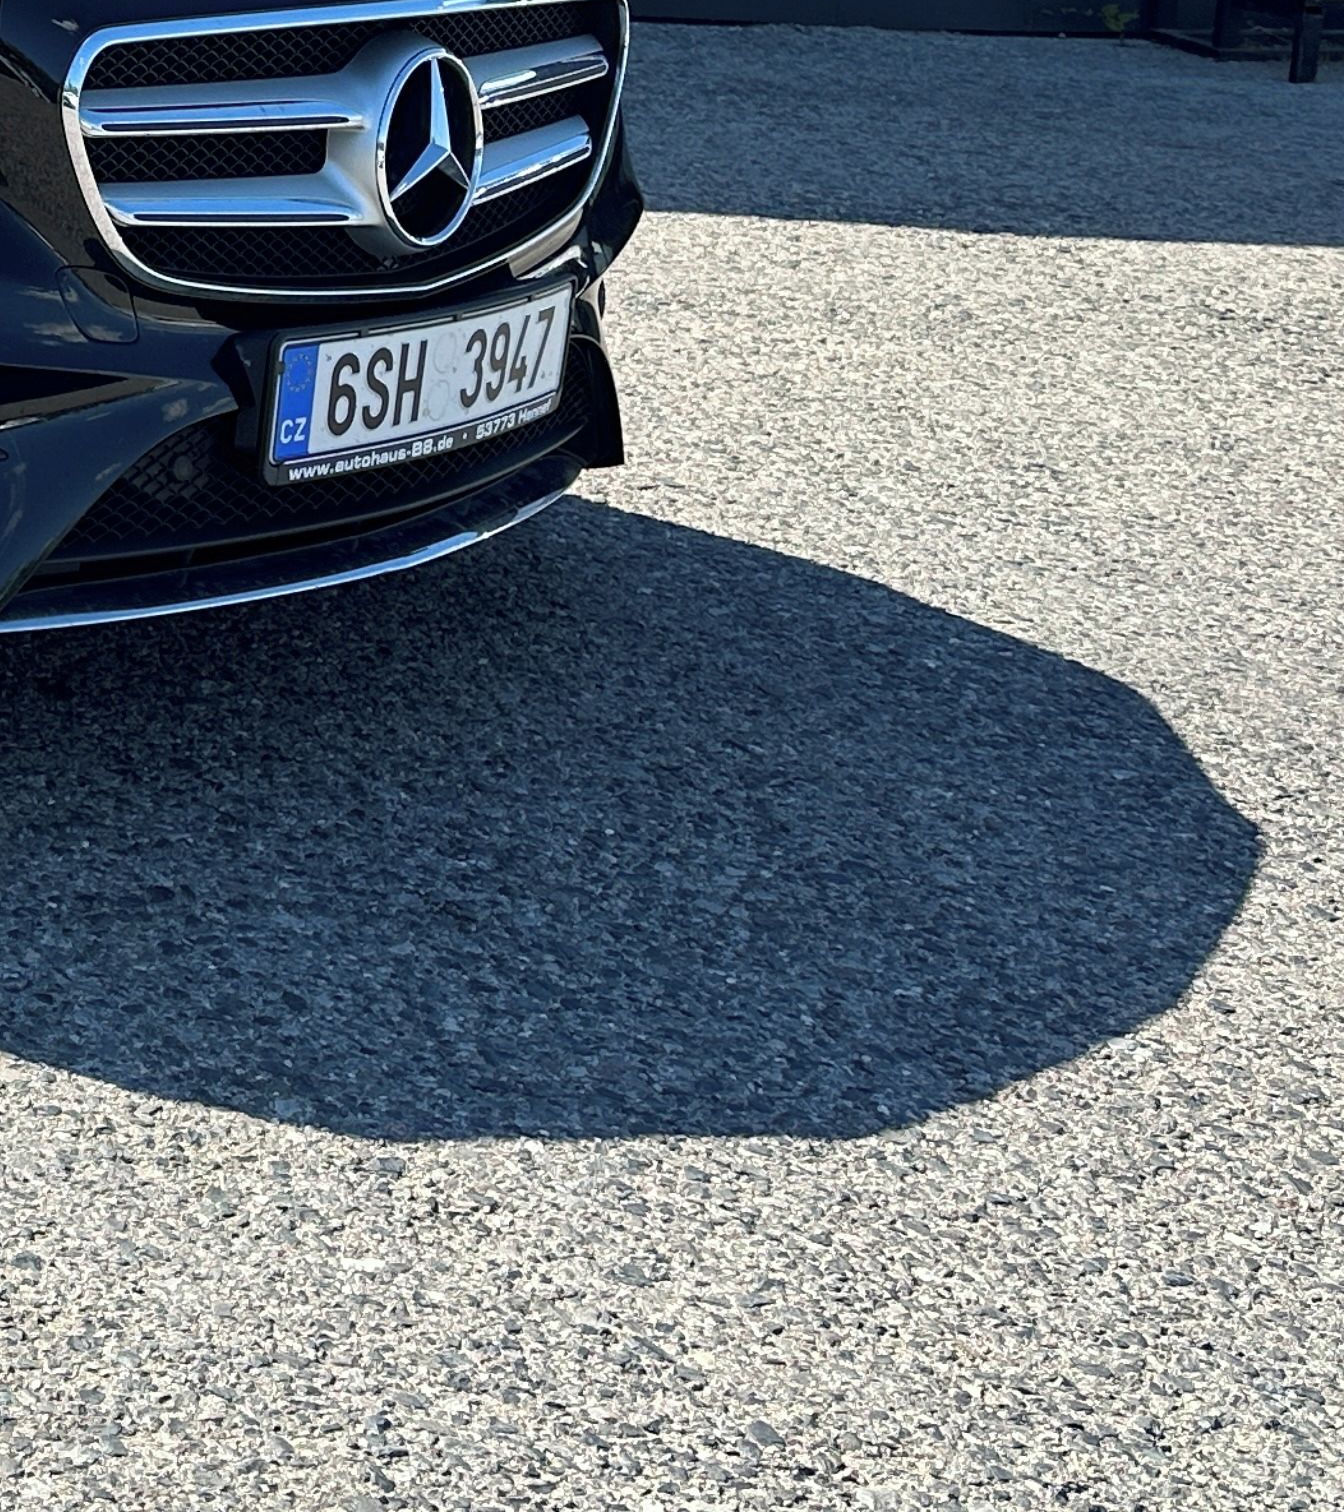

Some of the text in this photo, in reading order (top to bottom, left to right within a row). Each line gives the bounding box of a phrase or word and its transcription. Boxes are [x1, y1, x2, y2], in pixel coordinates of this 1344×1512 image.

[327, 306, 556, 436] 6SH 3947
[279, 417, 307, 444] CZ
[475, 414, 516, 440] 53773
